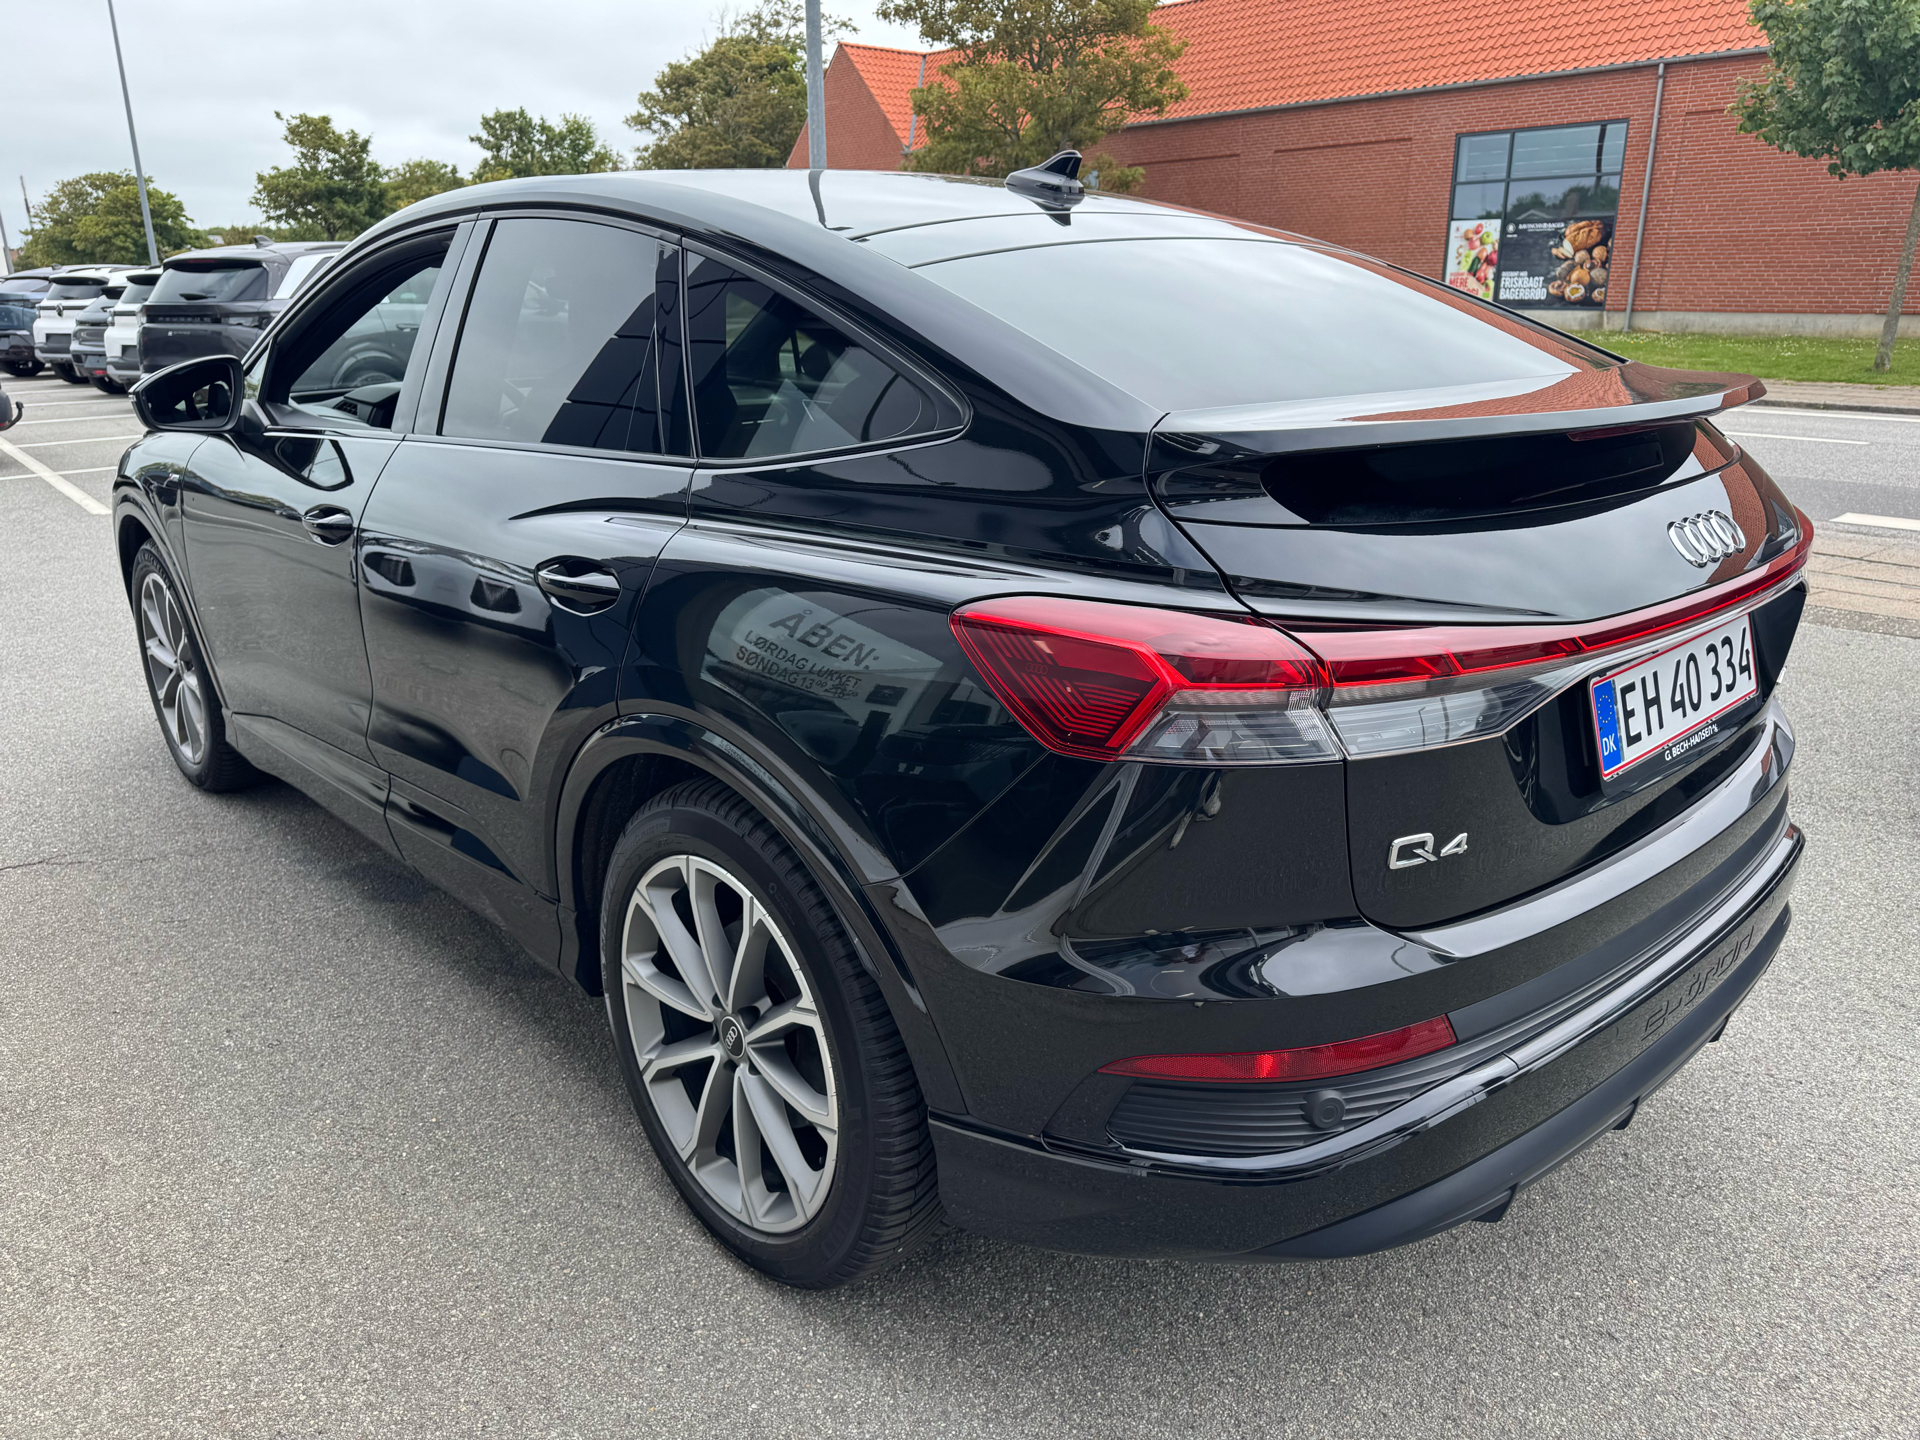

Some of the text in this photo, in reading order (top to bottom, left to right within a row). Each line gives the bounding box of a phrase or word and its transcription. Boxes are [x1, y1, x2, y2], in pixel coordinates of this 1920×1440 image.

[1449, 277, 1469, 288] MERE
[1499, 288, 1548, 301] BAGERBRØD
[1500, 276, 1545, 289] FRISKBAGT
[736, 646, 800, 685] SØNDAG
[744, 630, 862, 689] LØRDAG LUKKET
[1619, 626, 1752, 748] EH 40 334
[1602, 733, 1617, 757] DK
[1671, 725, 1714, 758] BECH-HANSEN
